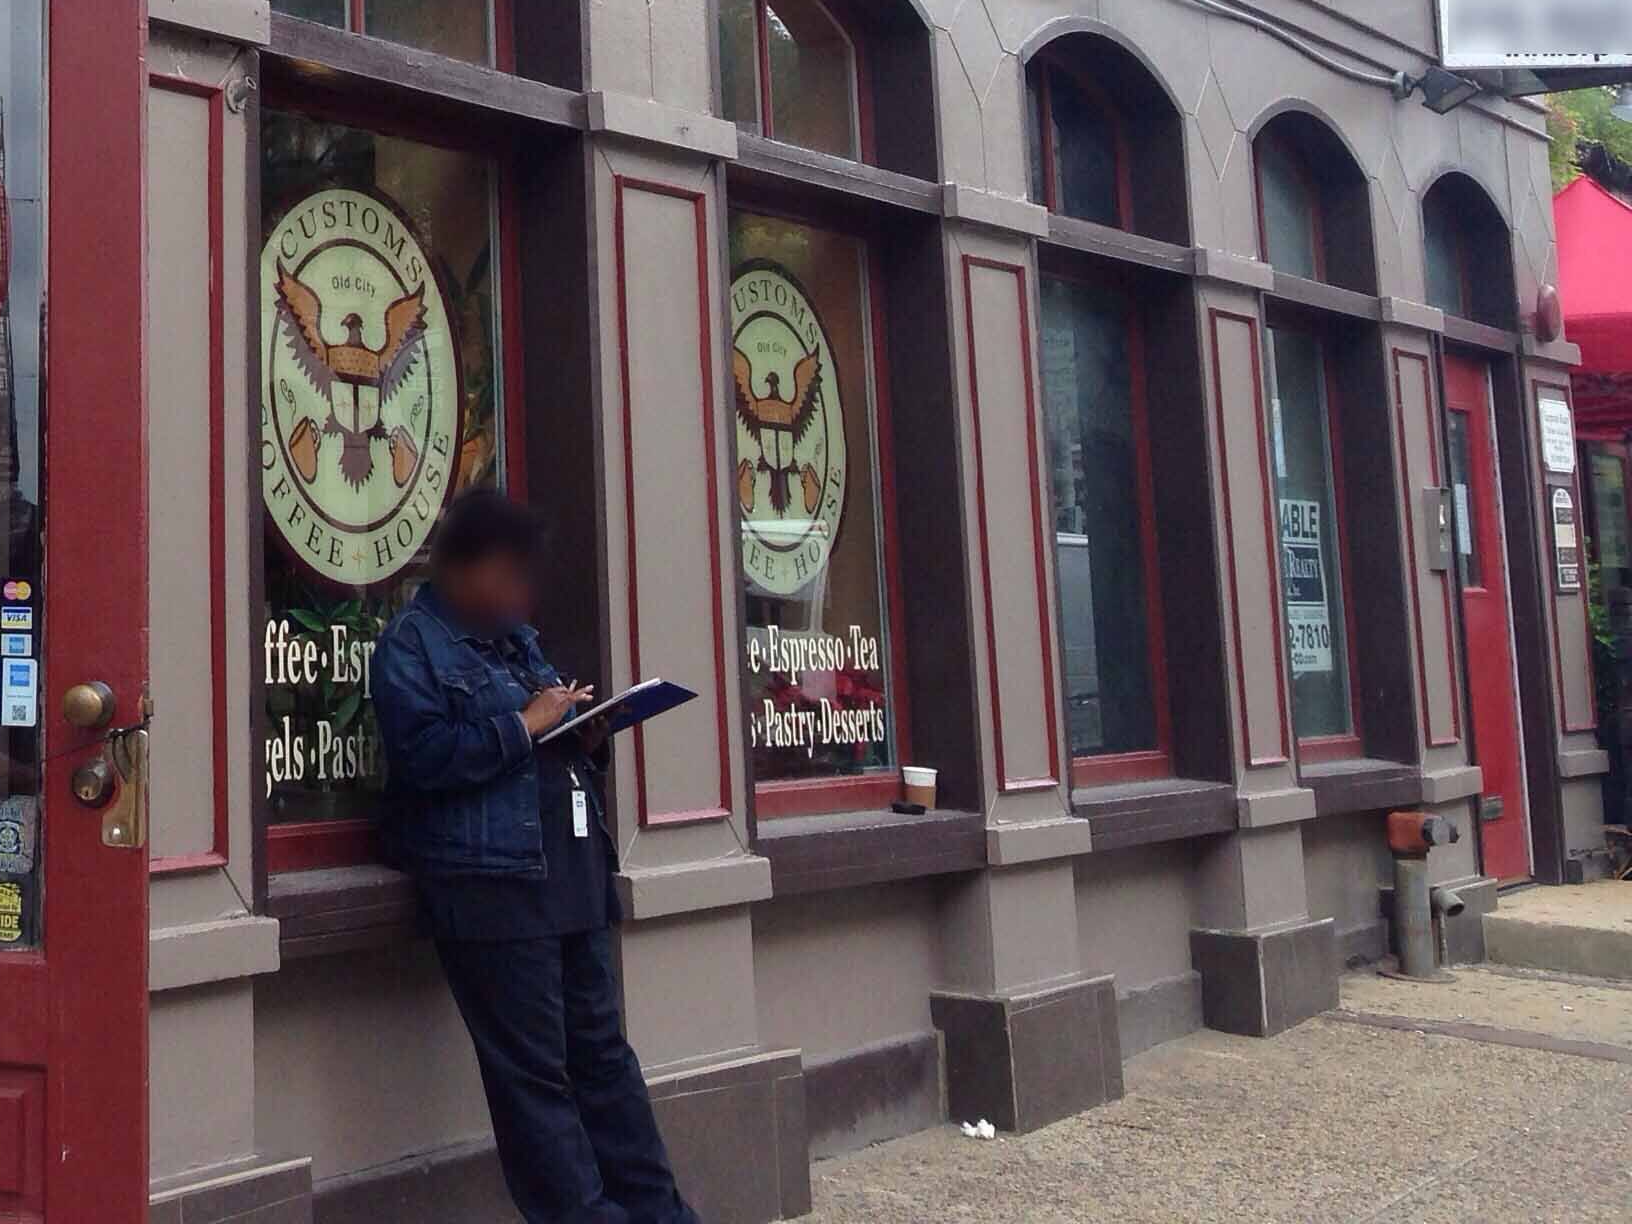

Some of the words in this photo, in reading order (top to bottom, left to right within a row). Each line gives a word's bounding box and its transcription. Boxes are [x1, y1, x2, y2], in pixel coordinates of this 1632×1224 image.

[279, 200, 422, 284] CUSTOMS
[332, 274, 351, 289] Old
[373, 431, 449, 570] HOUSE
[6, 613, 27, 623] VISA
[767, 624, 845, 685] Espresso
[849, 625, 880, 671] Tea
[763, 698, 815, 759] Pastry
[819, 697, 885, 745] Desserts
